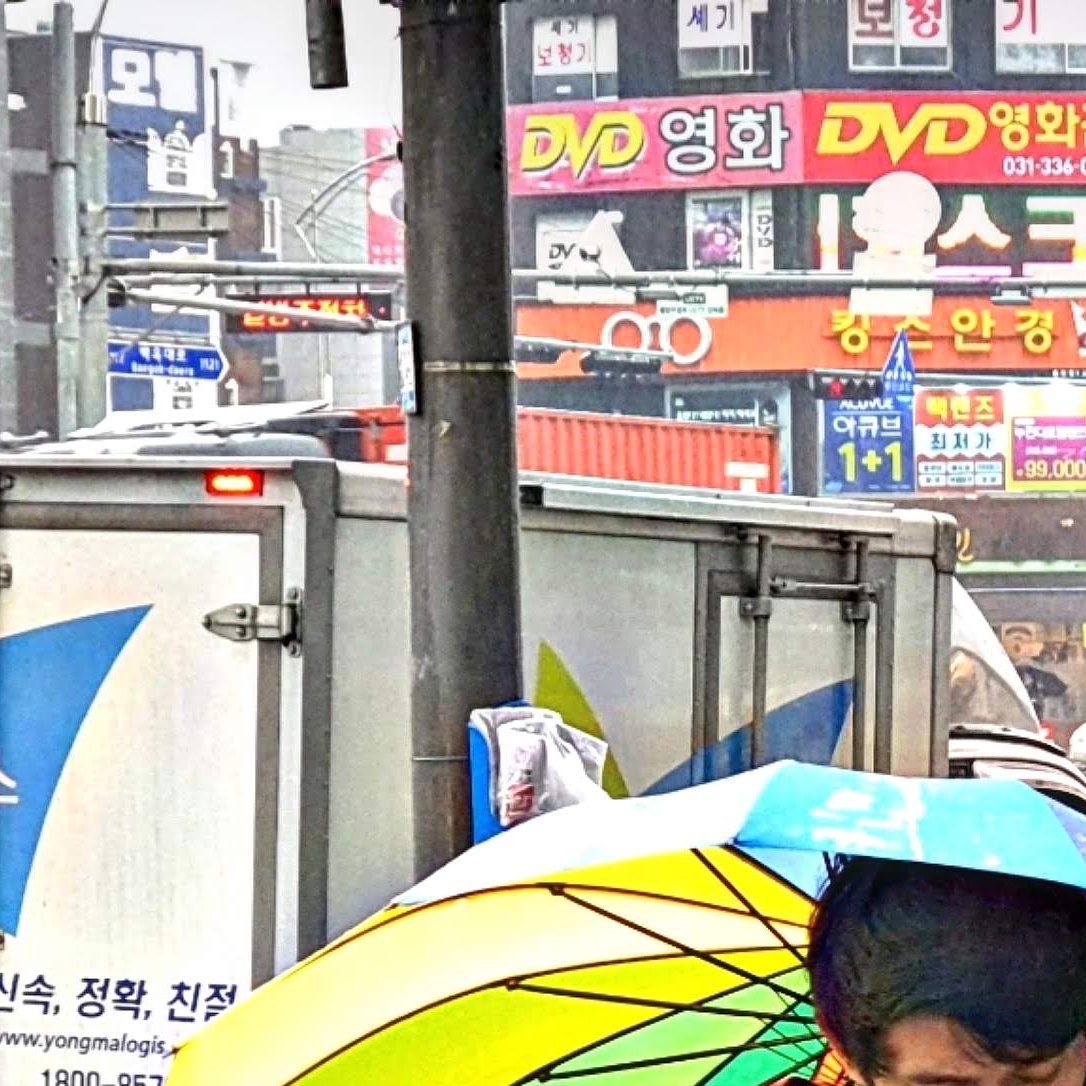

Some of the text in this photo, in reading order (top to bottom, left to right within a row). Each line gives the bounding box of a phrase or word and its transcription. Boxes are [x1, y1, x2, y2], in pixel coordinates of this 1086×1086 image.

[520, 104, 790, 178] DVD 영화
[816, 101, 988, 165] DVD
[837, 441, 903, 483] 1+1
[76, 978, 151, 1020] 정확,
